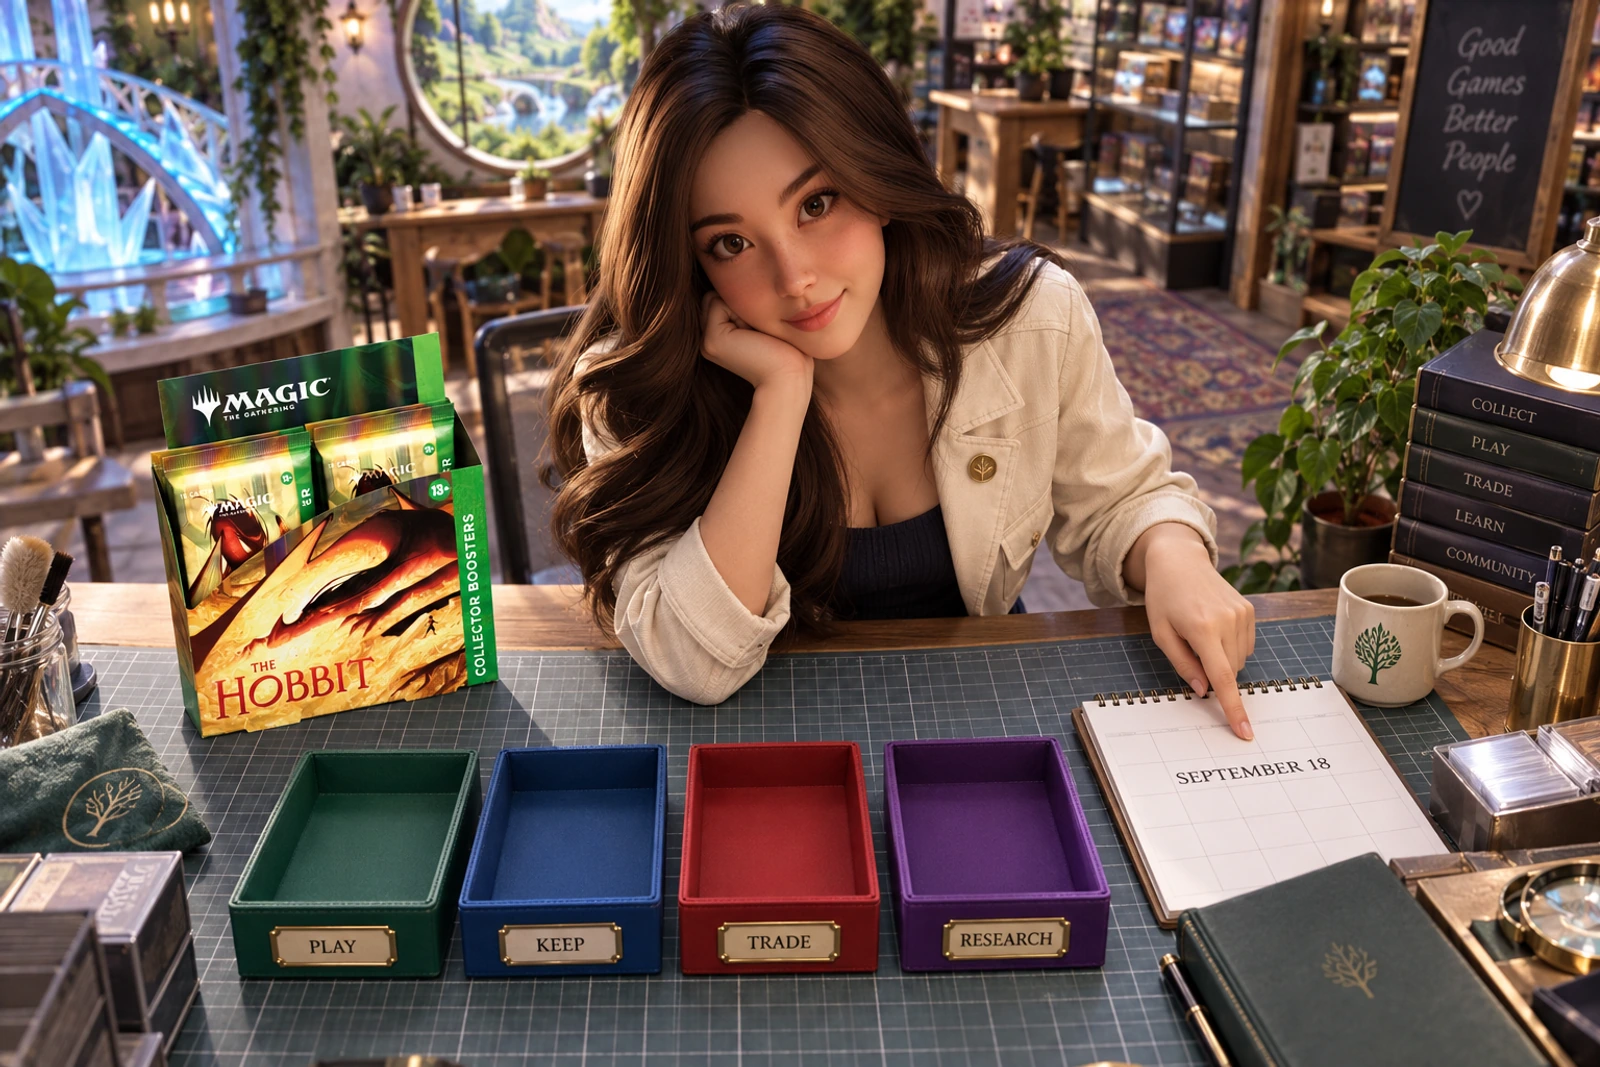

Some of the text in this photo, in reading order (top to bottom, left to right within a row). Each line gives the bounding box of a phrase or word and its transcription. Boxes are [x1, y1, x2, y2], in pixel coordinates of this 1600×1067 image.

[1458, 24, 1526, 62] Good
[1447, 66, 1526, 99] Games
[1443, 103, 1518, 134] Better
[1442, 140, 1516, 182] People
[222, 378, 331, 413] MAGIC
[244, 404, 295, 418] GATHERING
[1471, 397, 1537, 424] COLLECT
[1472, 435, 1510, 457] PLAY
[1463, 472, 1513, 498] TRADE
[219, 492, 275, 513] MAGIC
[1455, 509, 1505, 534] LEARN
[1446, 546, 1537, 582] COMMUNITY
[463, 513, 486, 677] COLLECTOR BOOSTERS
[251, 660, 276, 673] THE
[215, 656, 375, 720] HOBBIT
[1176, 757, 1331, 785] SEPTEMBER 18
[309, 939, 357, 954] PLAY
[536, 937, 586, 952] KEEP
[747, 934, 812, 950] TRADE
[960, 932, 1054, 947] RESEARCH
